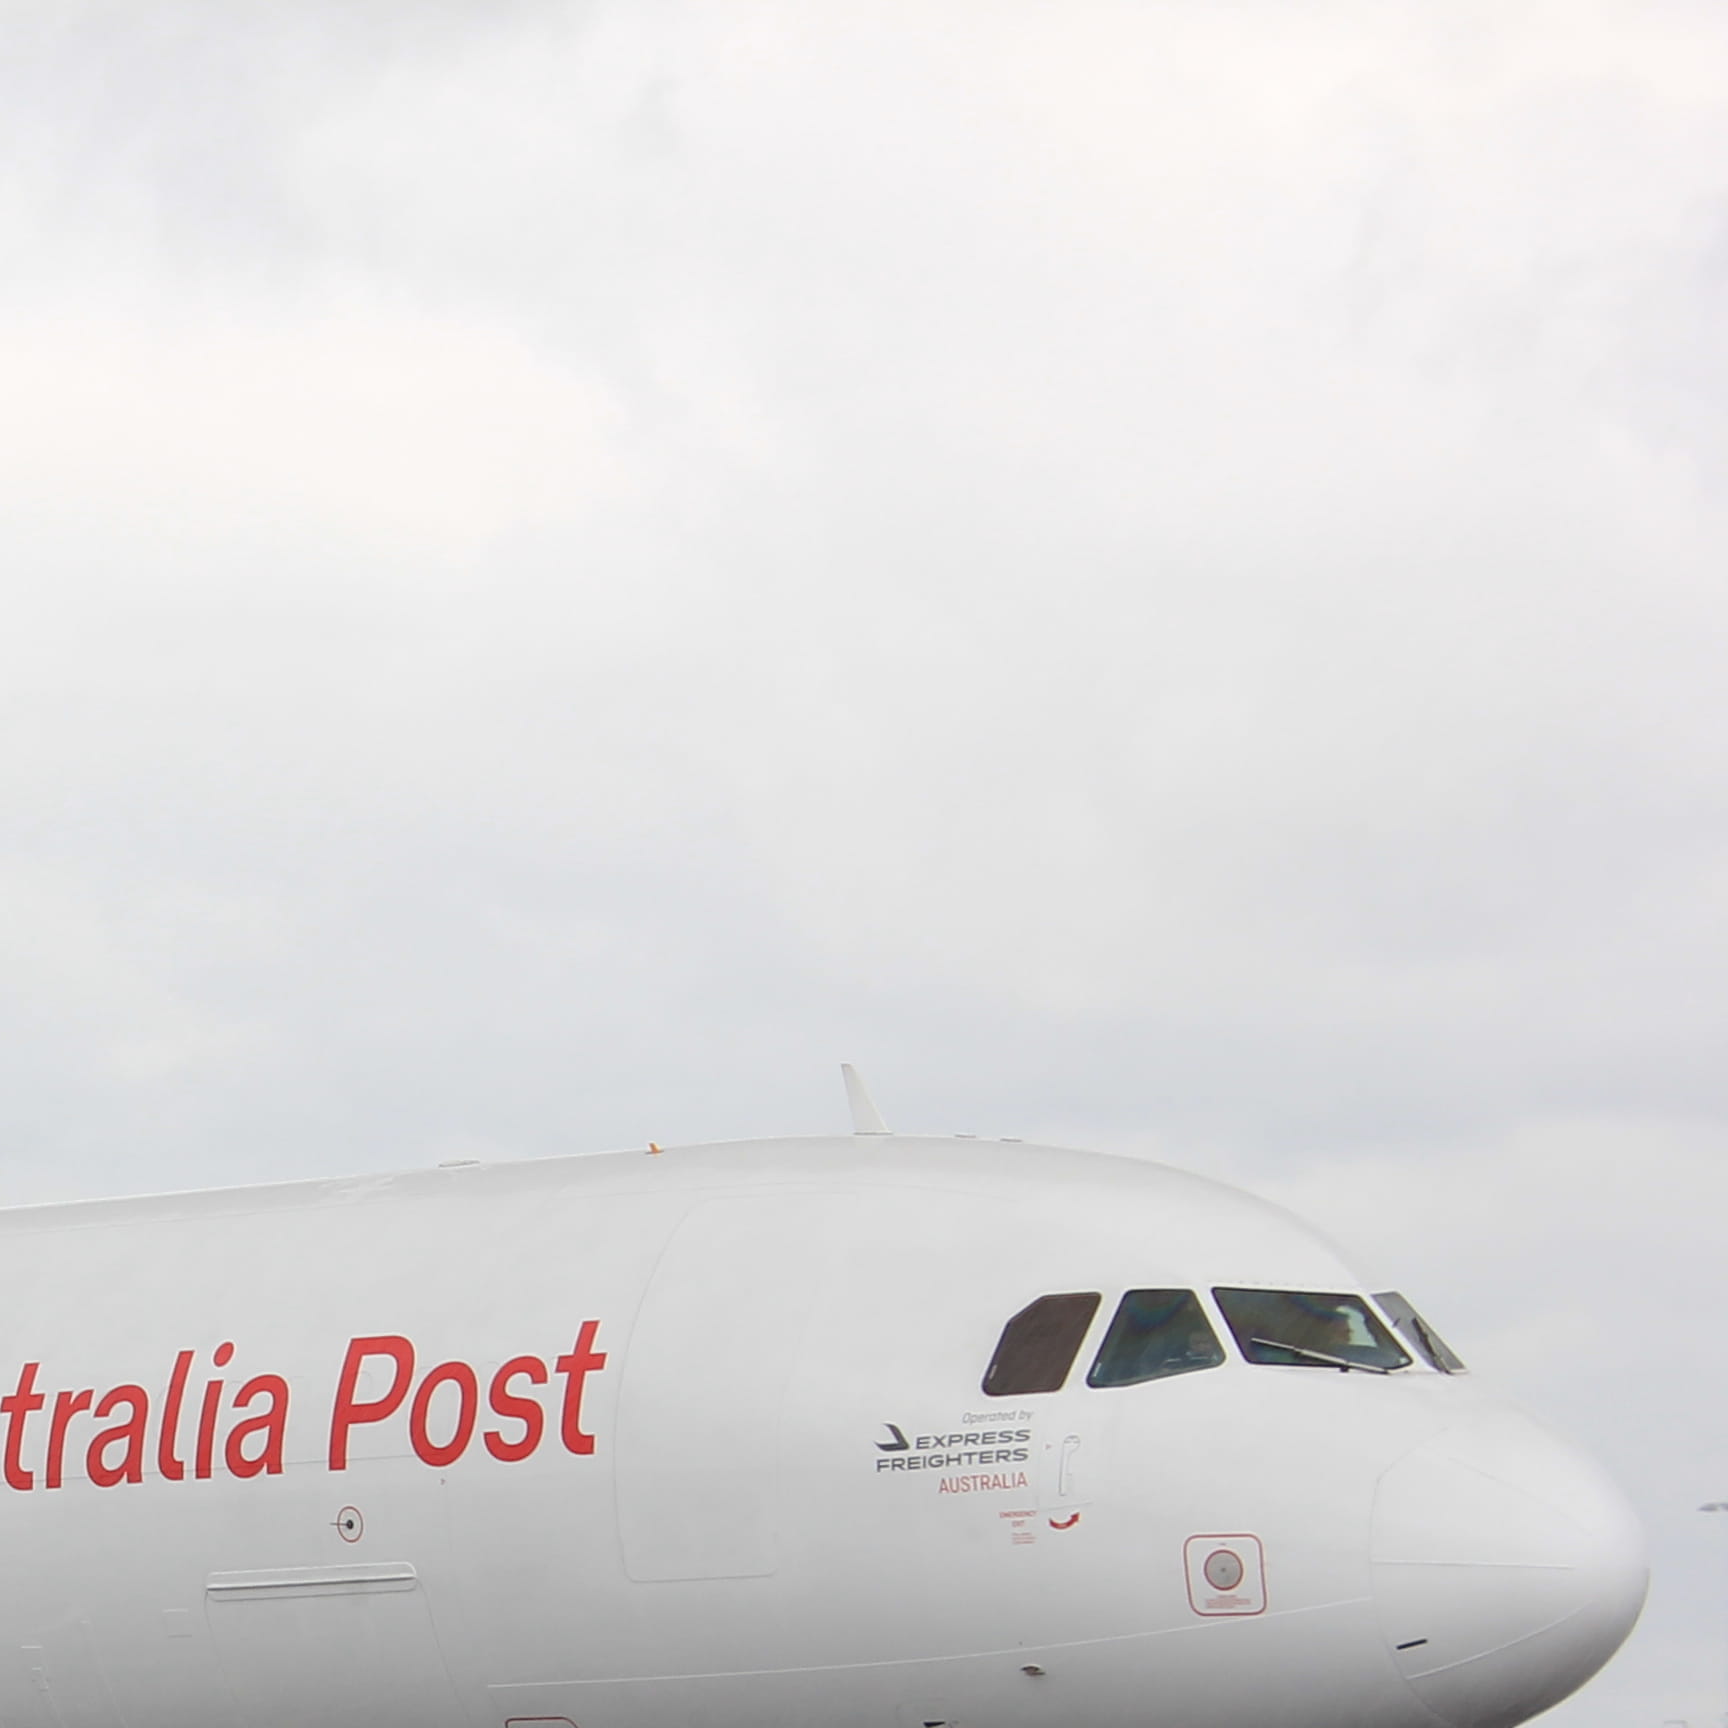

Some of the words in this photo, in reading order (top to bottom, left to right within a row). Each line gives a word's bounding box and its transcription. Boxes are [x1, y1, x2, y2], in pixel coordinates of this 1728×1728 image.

[326, 1318, 608, 1473] Post
[915, 1429, 1032, 1450] EXPRESS
[876, 1447, 1029, 1473] FREIGHTERS
[938, 1471, 1029, 1494] AUSTRALIA
